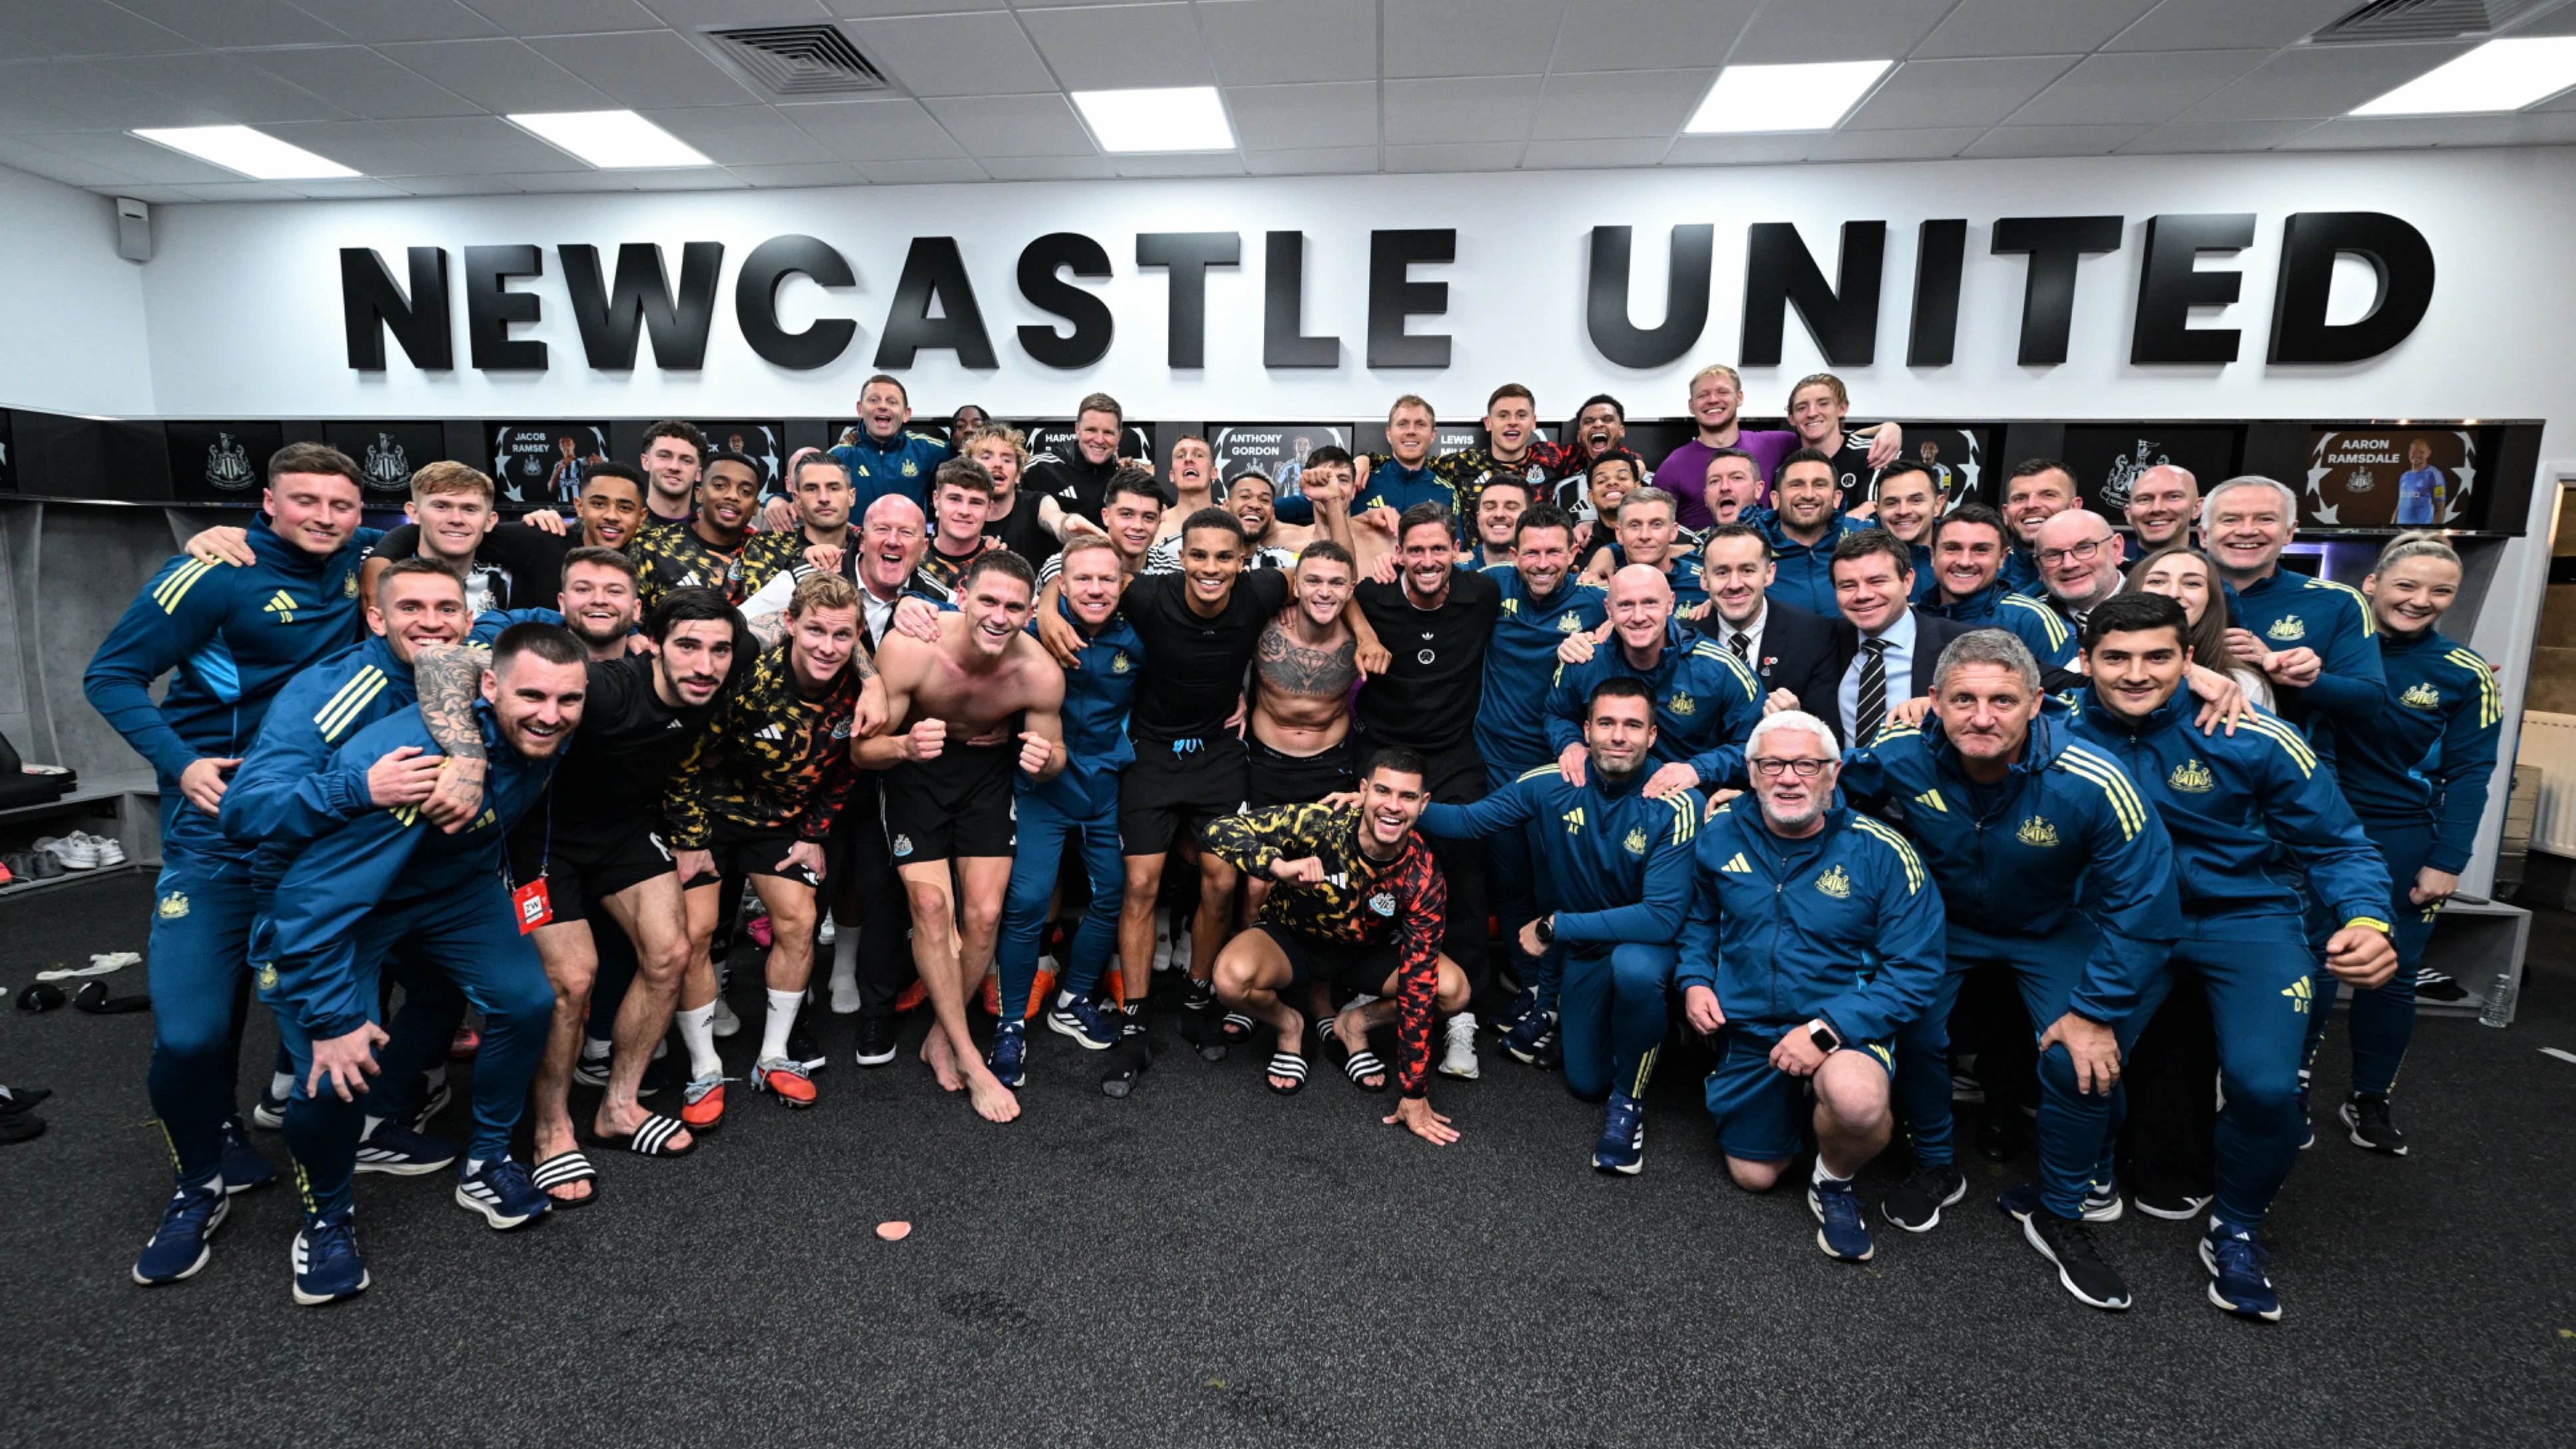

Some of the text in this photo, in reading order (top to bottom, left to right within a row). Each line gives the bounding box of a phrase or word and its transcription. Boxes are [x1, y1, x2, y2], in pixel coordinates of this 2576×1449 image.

[339, 212, 2435, 371] NEWCASTLE UNITED
[1230, 434, 1282, 443] ANTHONY
[1441, 435, 1474, 445] LEWIS
[512, 444, 550, 453] RAMSEY
[2341, 439, 2390, 449] AARON
[1232, 447, 1280, 455] GORDON
[2328, 453, 2400, 463] RAMSDALE
